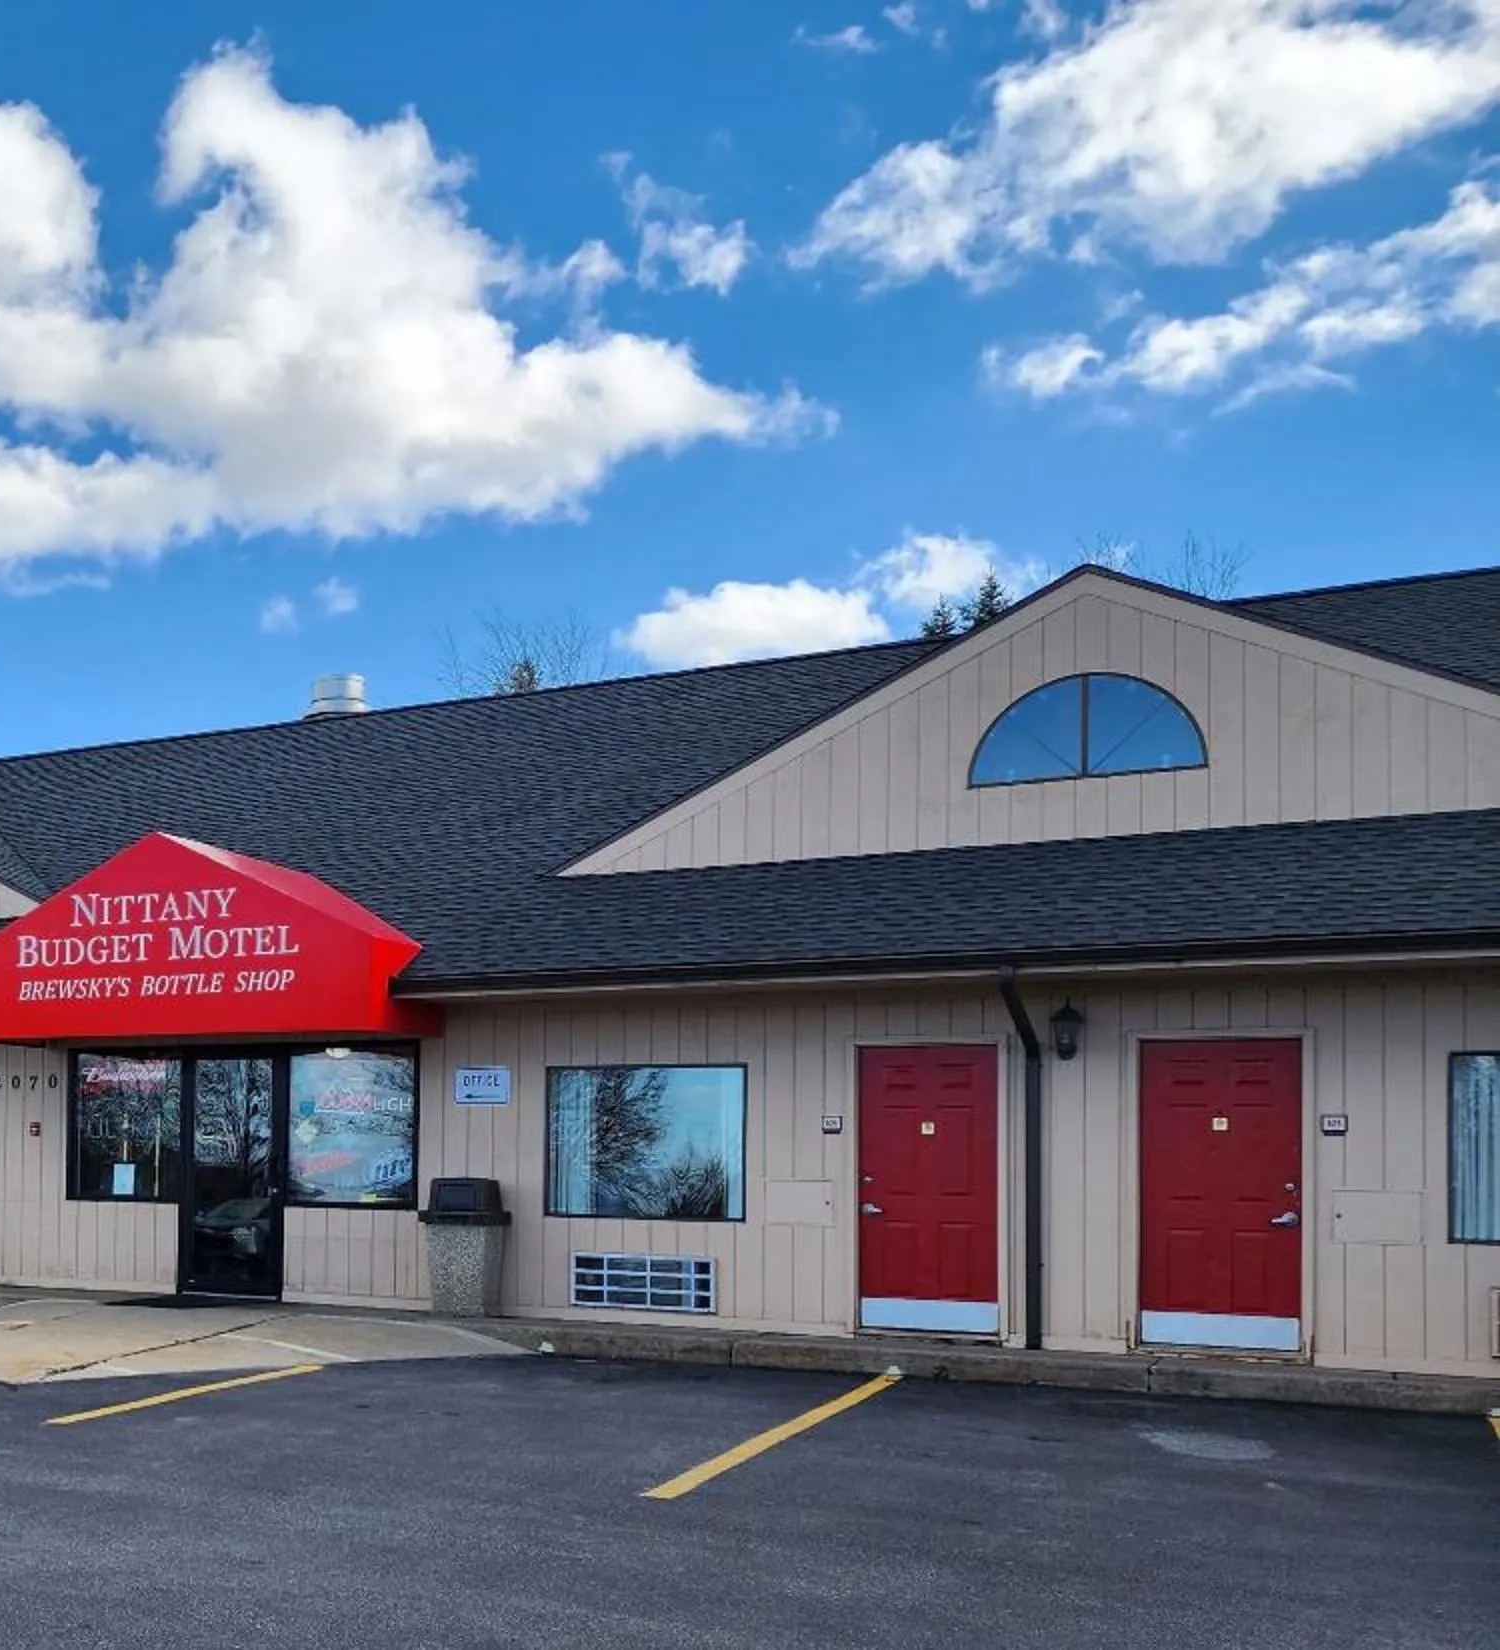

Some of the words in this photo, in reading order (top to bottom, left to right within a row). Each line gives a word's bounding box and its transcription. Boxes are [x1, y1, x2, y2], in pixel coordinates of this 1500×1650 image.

[69, 888, 236, 927] NITTANY
[16, 933, 153, 968] BUDGET
[168, 925, 299, 960] MOTEL
[19, 976, 131, 1001] BREWSKY'S
[141, 972, 225, 996] BOTTLE
[234, 969, 295, 993] SHOP
